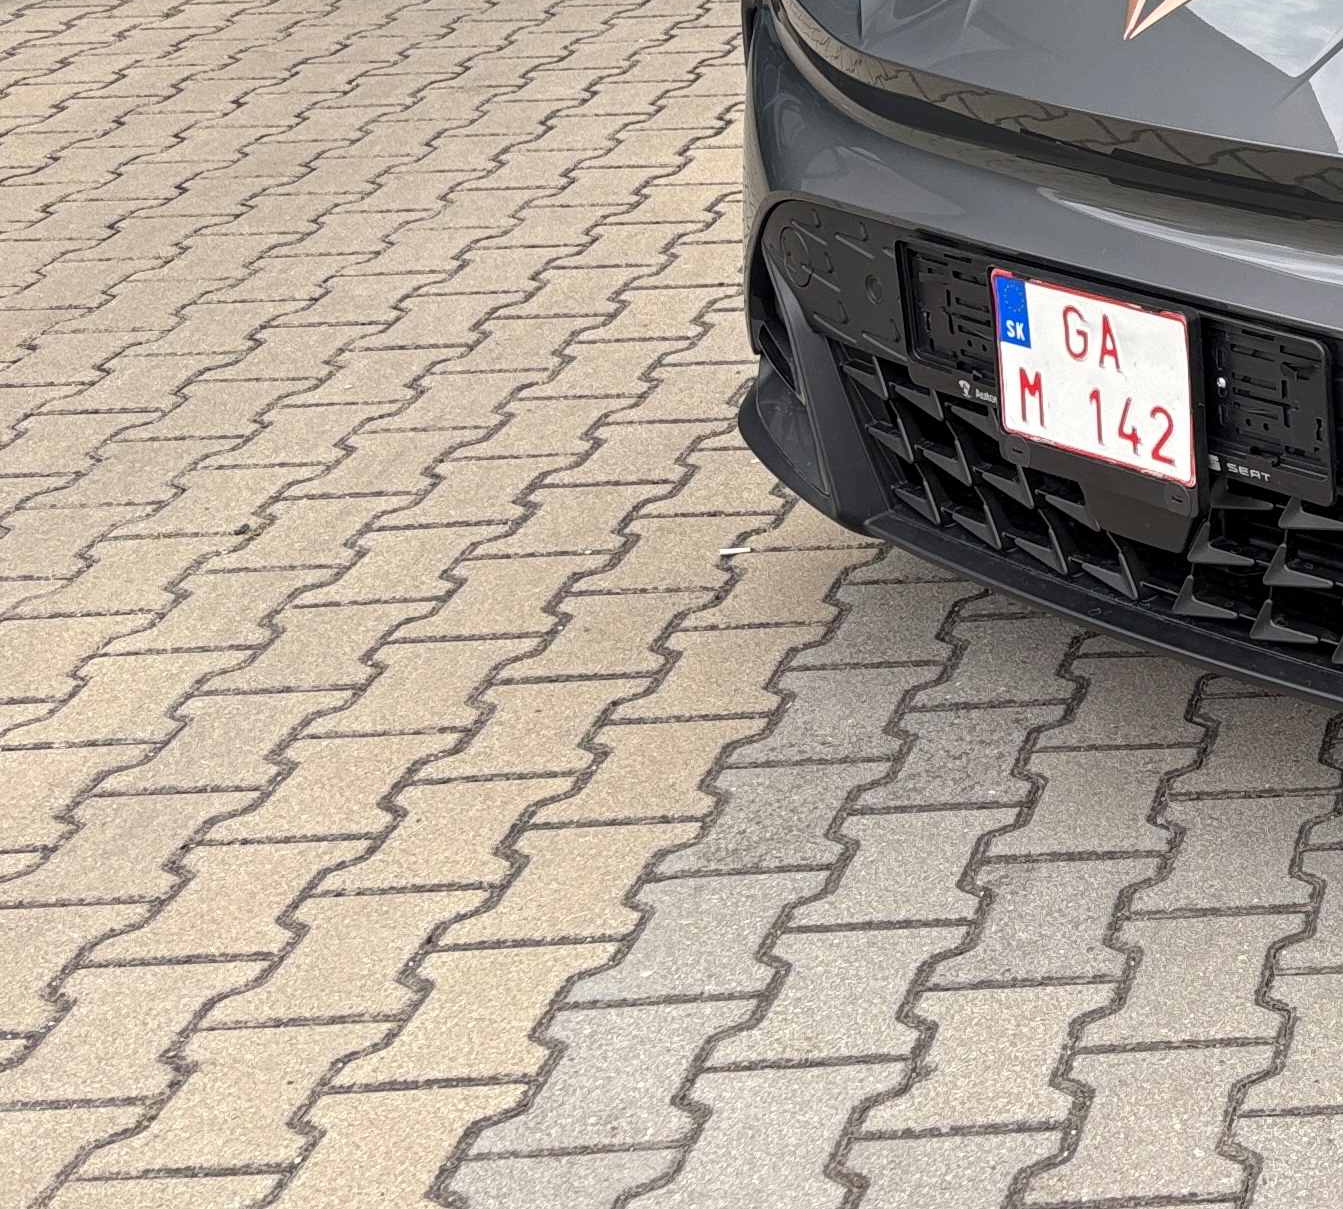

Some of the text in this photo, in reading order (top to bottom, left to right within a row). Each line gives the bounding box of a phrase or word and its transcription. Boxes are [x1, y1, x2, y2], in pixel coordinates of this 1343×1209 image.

[1006, 319, 1026, 341] SK
[1062, 304, 1122, 373] GA
[1018, 366, 1177, 468] M 142
[1226, 462, 1271, 482] SEAT
